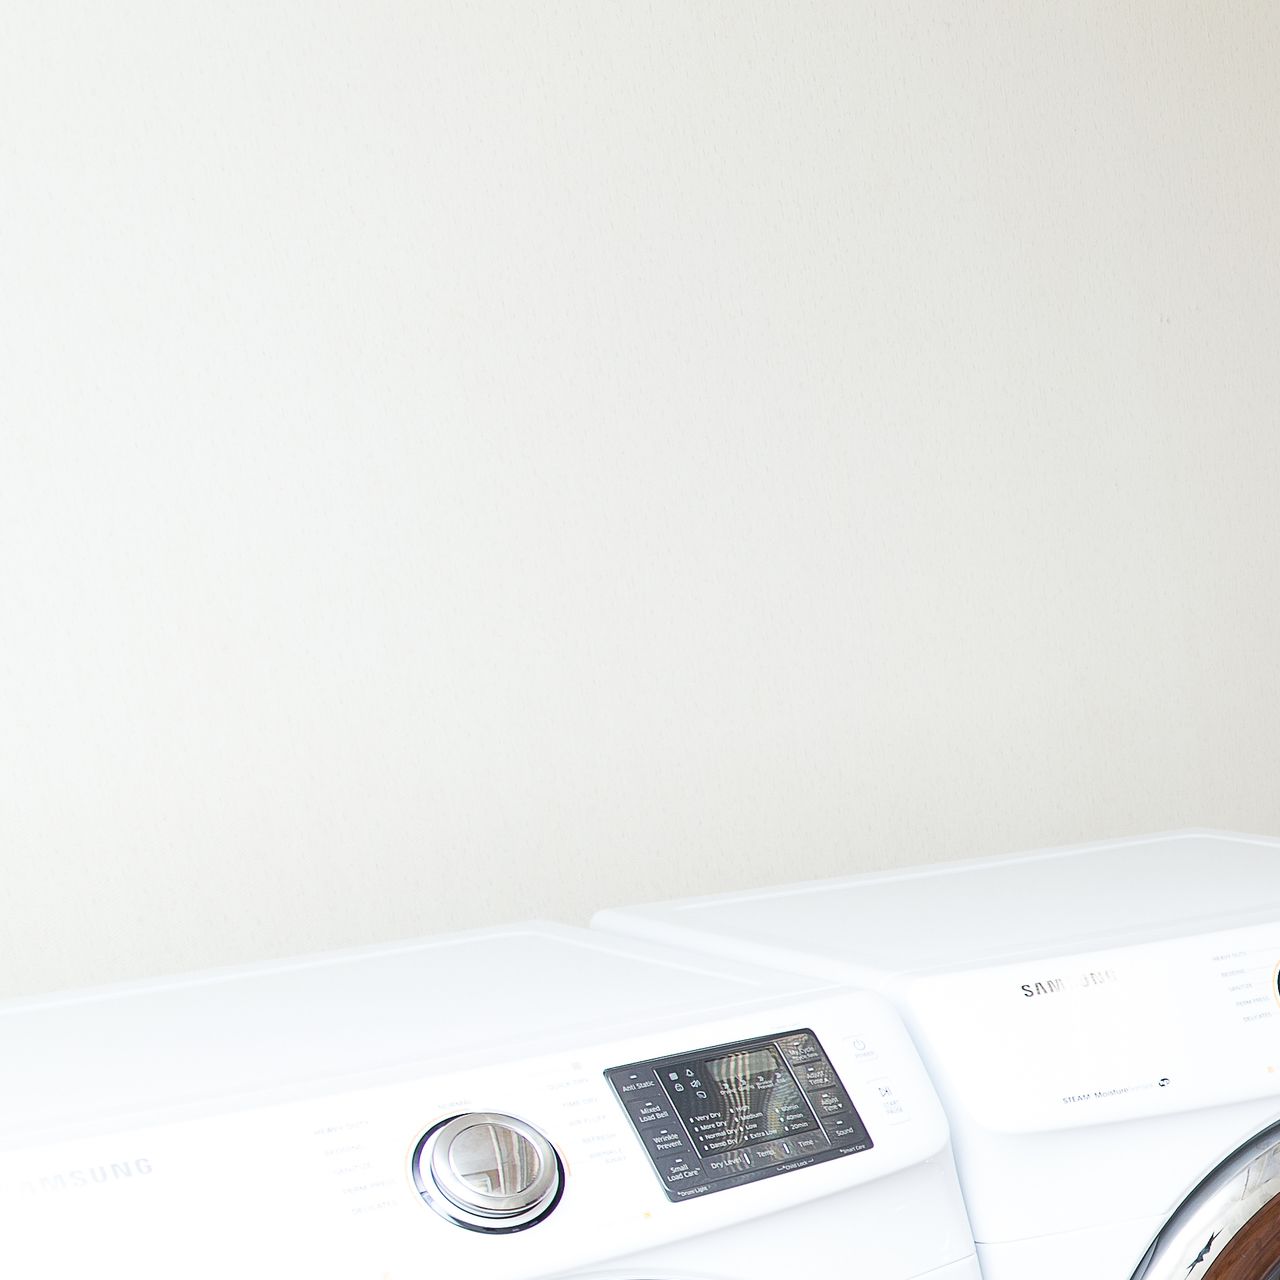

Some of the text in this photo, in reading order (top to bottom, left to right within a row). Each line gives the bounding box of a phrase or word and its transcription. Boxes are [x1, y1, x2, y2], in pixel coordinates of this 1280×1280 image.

[1021, 969, 1117, 998] SAMUN
[636, 1080, 655, 1089] Static
[639, 1113, 656, 1123] Load
[694, 1113, 710, 1122] Very
[700, 1123, 716, 1131] More
[835, 1127, 854, 1137] Sound
[653, 1133, 679, 1144] Wrinkle
[704, 1130, 726, 1140] Normal
[657, 1141, 683, 1151] Prevent
[709, 1141, 727, 1150] Damp
[670, 1164, 689, 1174] Small
[710, 1161, 724, 1170] Dry
[4, 1158, 152, 1199] AMSUNG
[667, 1172, 684, 1182] Load
